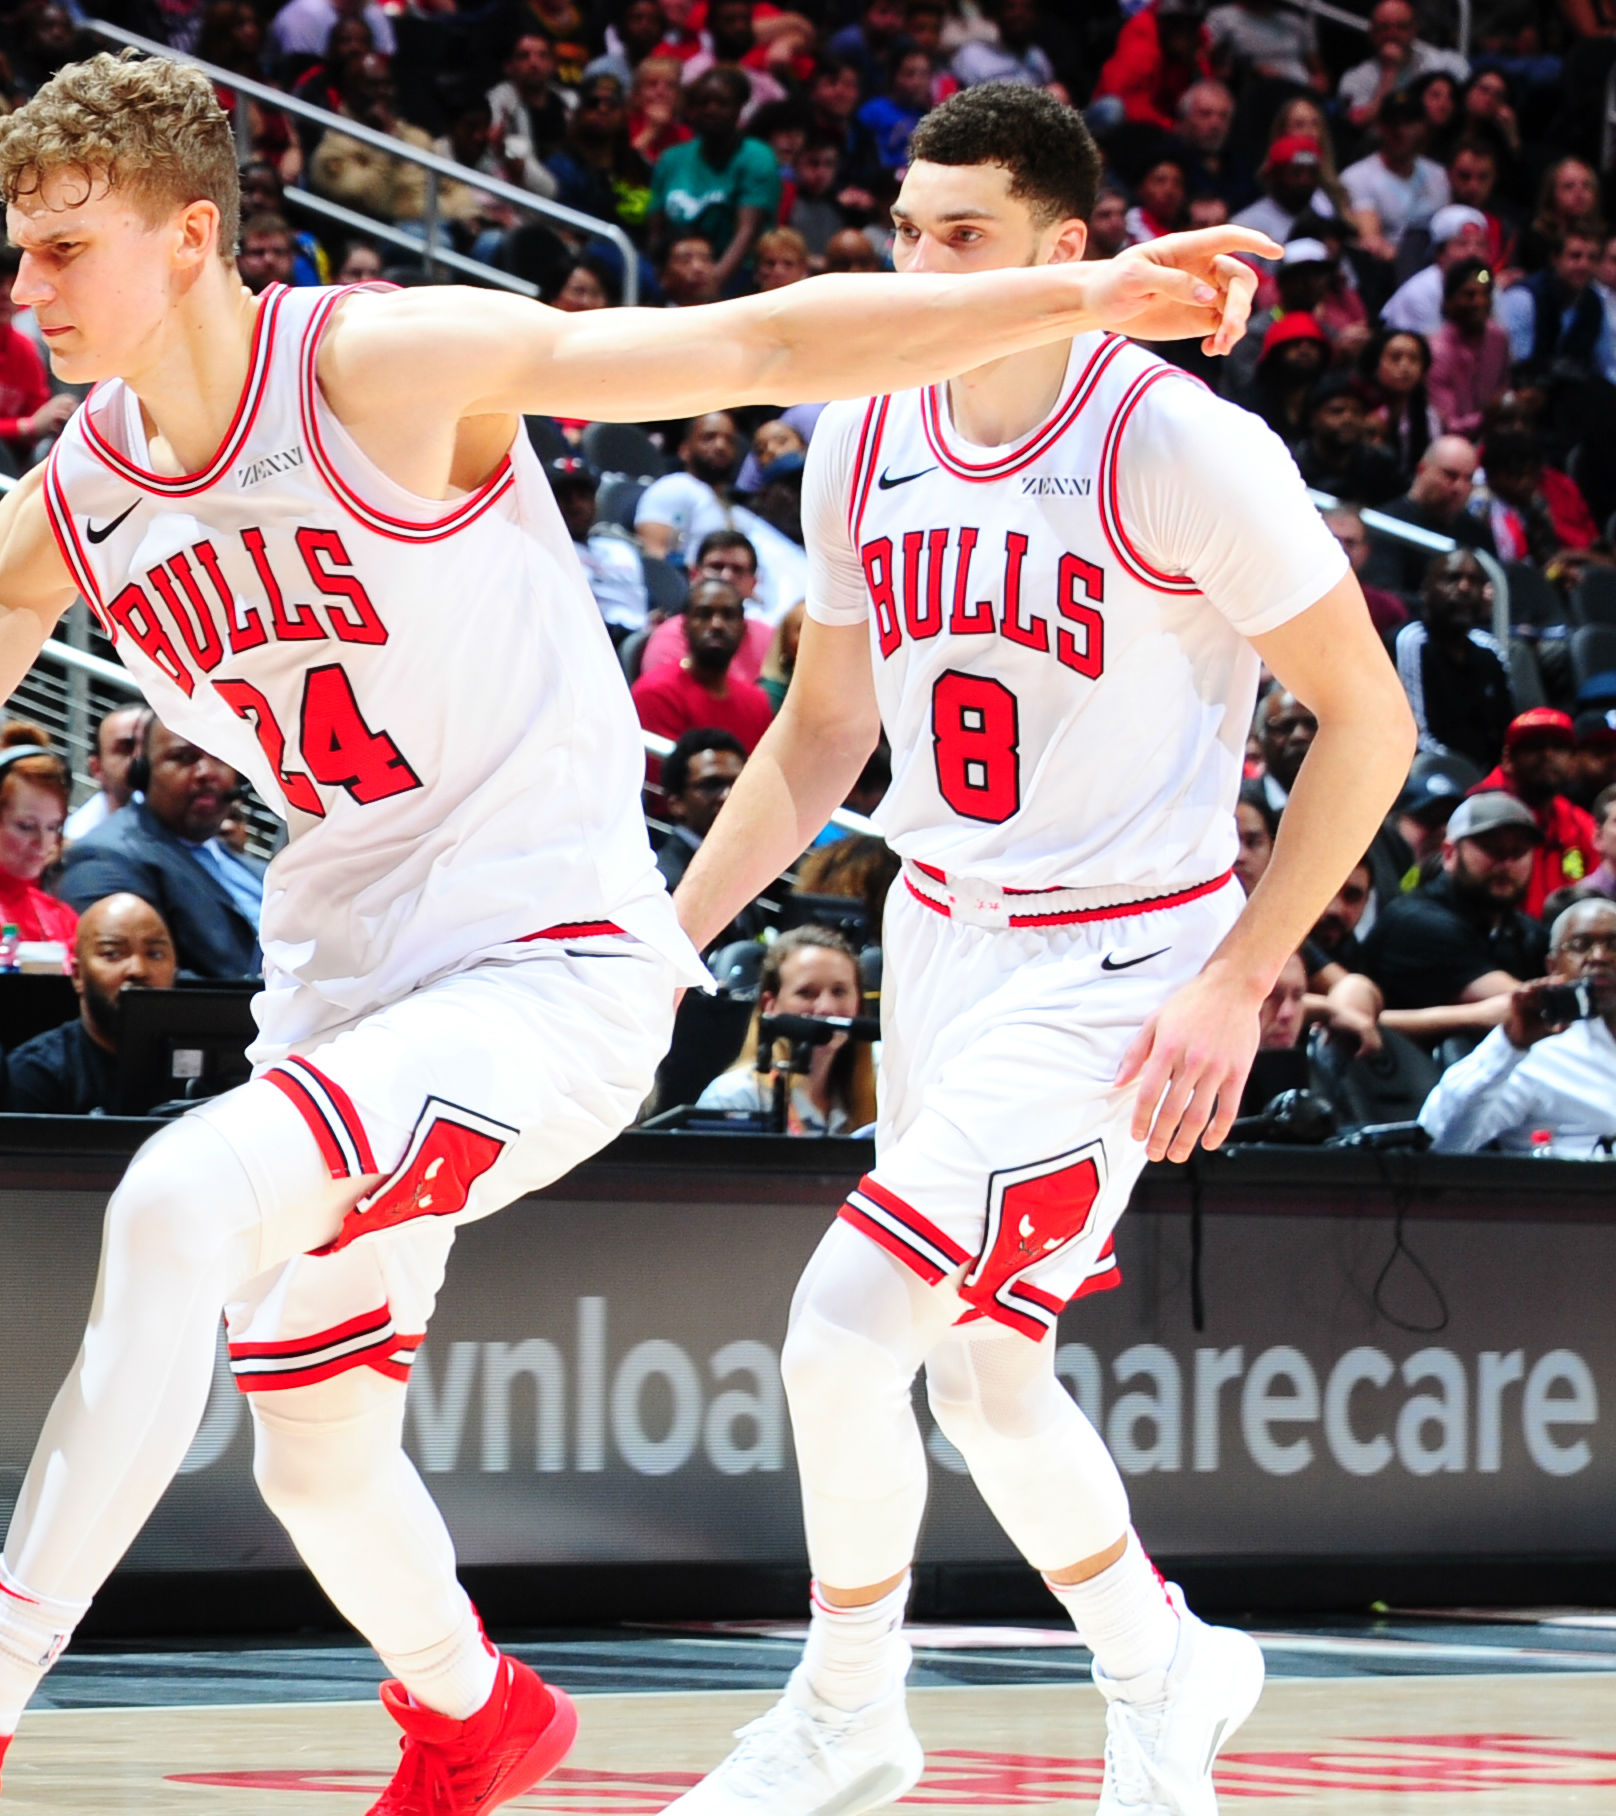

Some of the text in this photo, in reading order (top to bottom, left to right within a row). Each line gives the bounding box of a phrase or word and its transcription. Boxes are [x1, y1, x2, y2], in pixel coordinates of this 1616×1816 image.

[238, 446, 304, 488] ZENNI
[1021, 477, 1092, 496] ZENNI
[107, 527, 389, 699] BULLS
[861, 527, 1104, 681] BULLS
[211, 662, 424, 819] 24
[931, 668, 1020, 825] 8
[928, 1344, 1599, 1476] arecare
